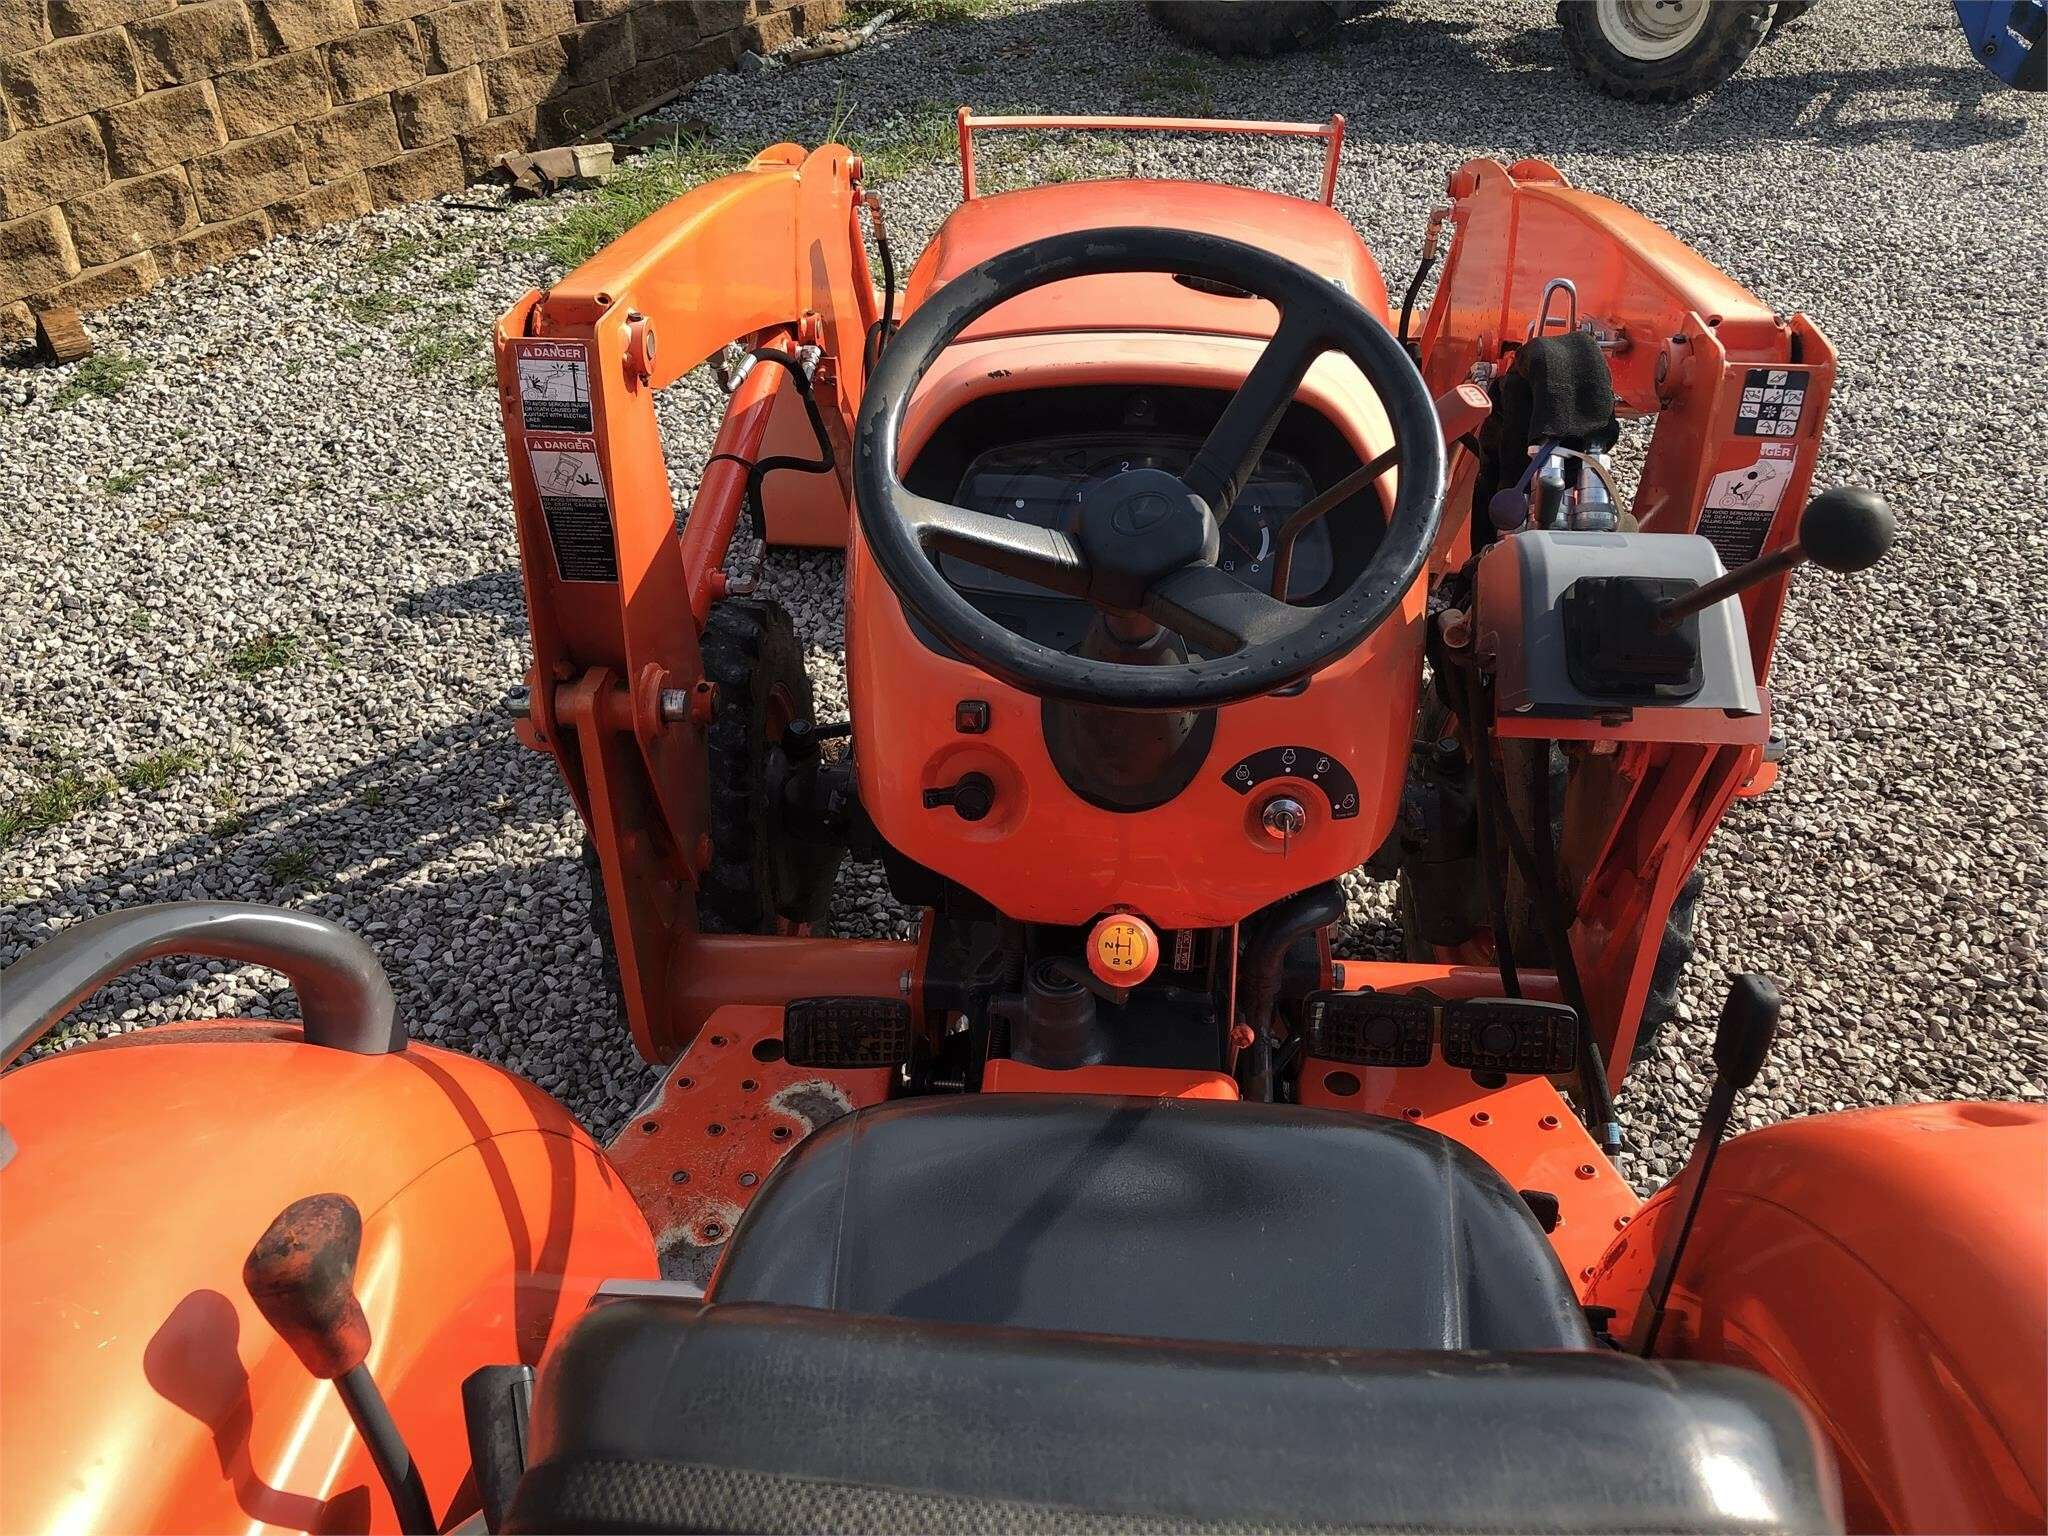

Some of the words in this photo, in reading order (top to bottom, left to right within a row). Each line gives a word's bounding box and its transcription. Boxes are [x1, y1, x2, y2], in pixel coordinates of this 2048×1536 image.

[534, 348, 581, 358] DANGER
[544, 441, 590, 450] DANGER
[1121, 461, 1130, 472] 2
[1076, 491, 1082, 502] 1
[1253, 505, 1261, 514] H
[1251, 564, 1260, 573] C
